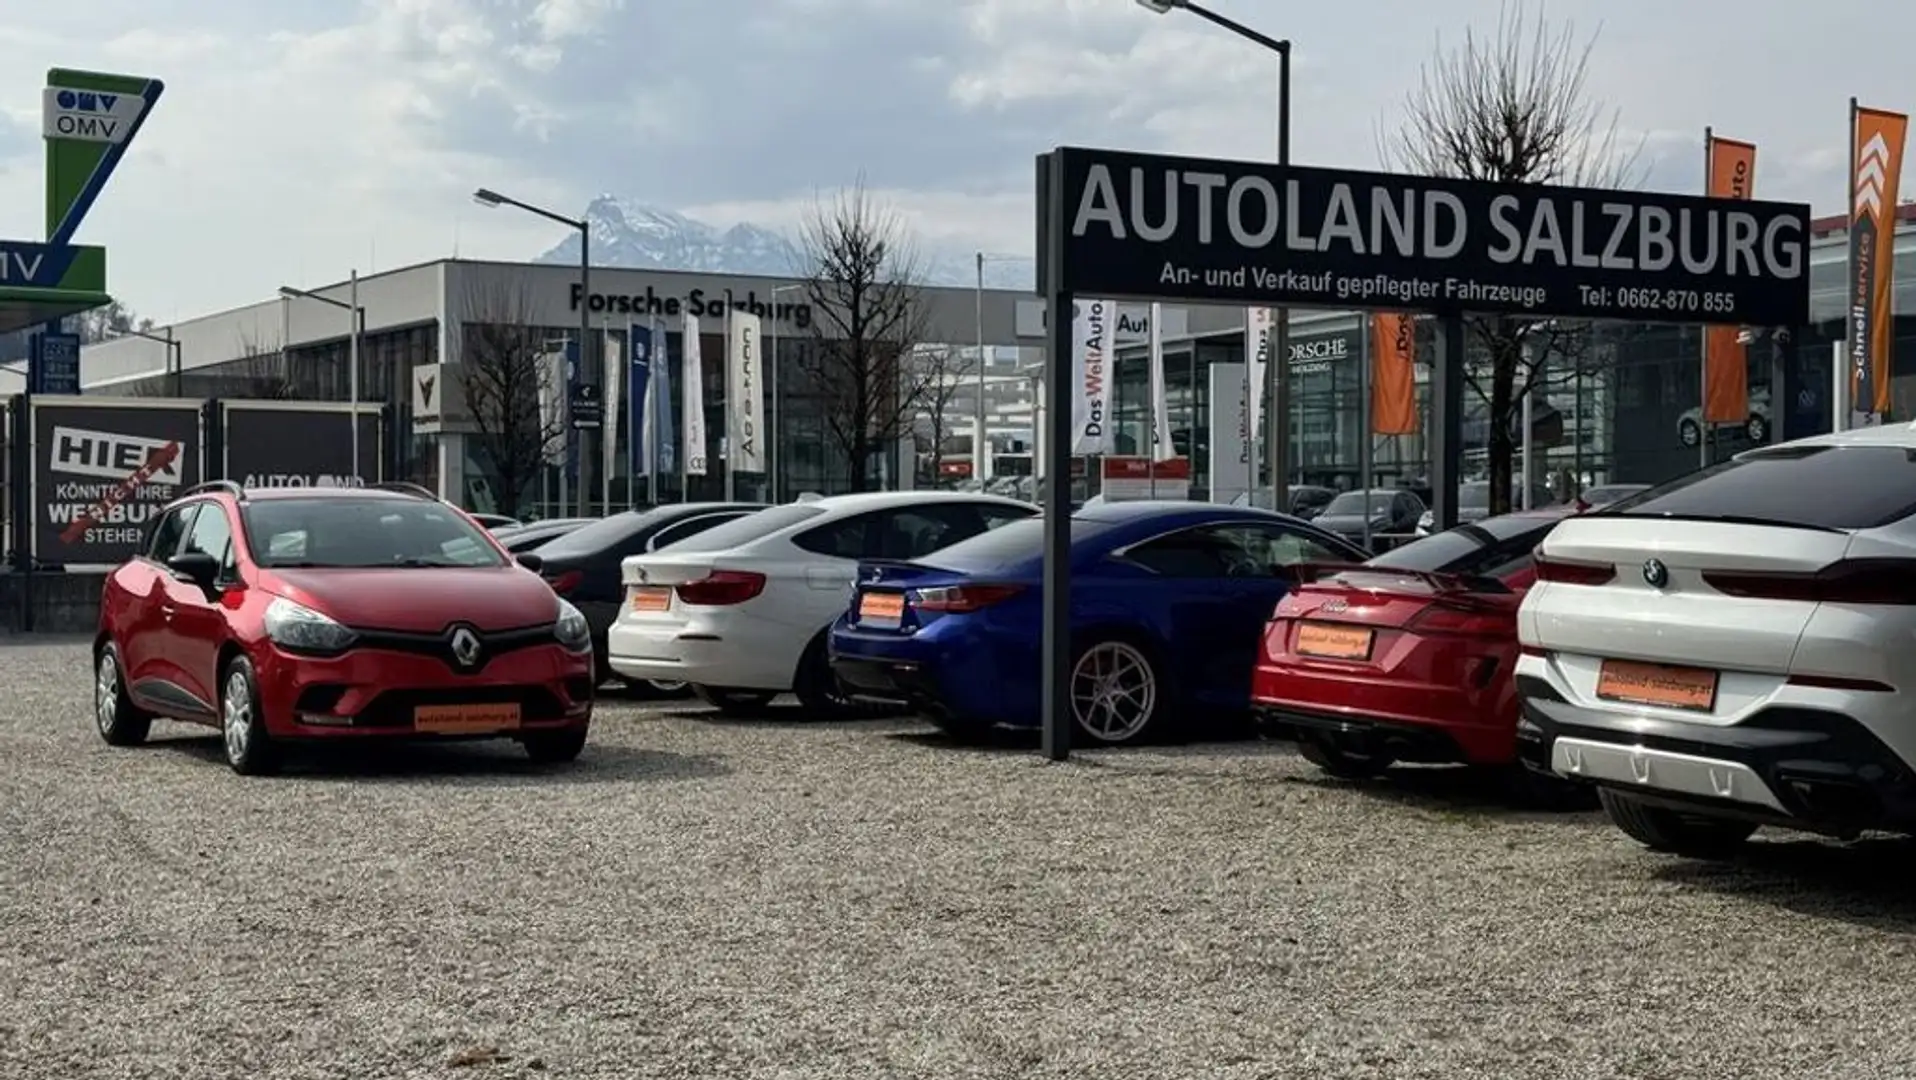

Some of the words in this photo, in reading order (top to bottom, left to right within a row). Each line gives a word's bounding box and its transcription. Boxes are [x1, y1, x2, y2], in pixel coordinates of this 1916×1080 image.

[57, 116, 116, 138] OMV
[1073, 165, 1467, 258] AUTOLAND
[1488, 195, 1801, 279] SALZBURG
[569, 283, 680, 316] Porsche
[688, 289, 812, 328] Salzburg
[1160, 262, 1199, 284] An-
[1205, 267, 1245, 287] und
[1252, 268, 1332, 292] Verkauf
[1337, 275, 1439, 301] gepflegter
[1445, 279, 1545, 307] Fahrzeuge
[1579, 286, 1612, 307] Tel:
[1618, 287, 1698, 310] 0662-870
[1703, 292, 1734, 312] 855
[1287, 337, 1348, 361] ORSCHE
[1085, 400, 1102, 437] Das
[136, 484, 173, 500] IHRE
